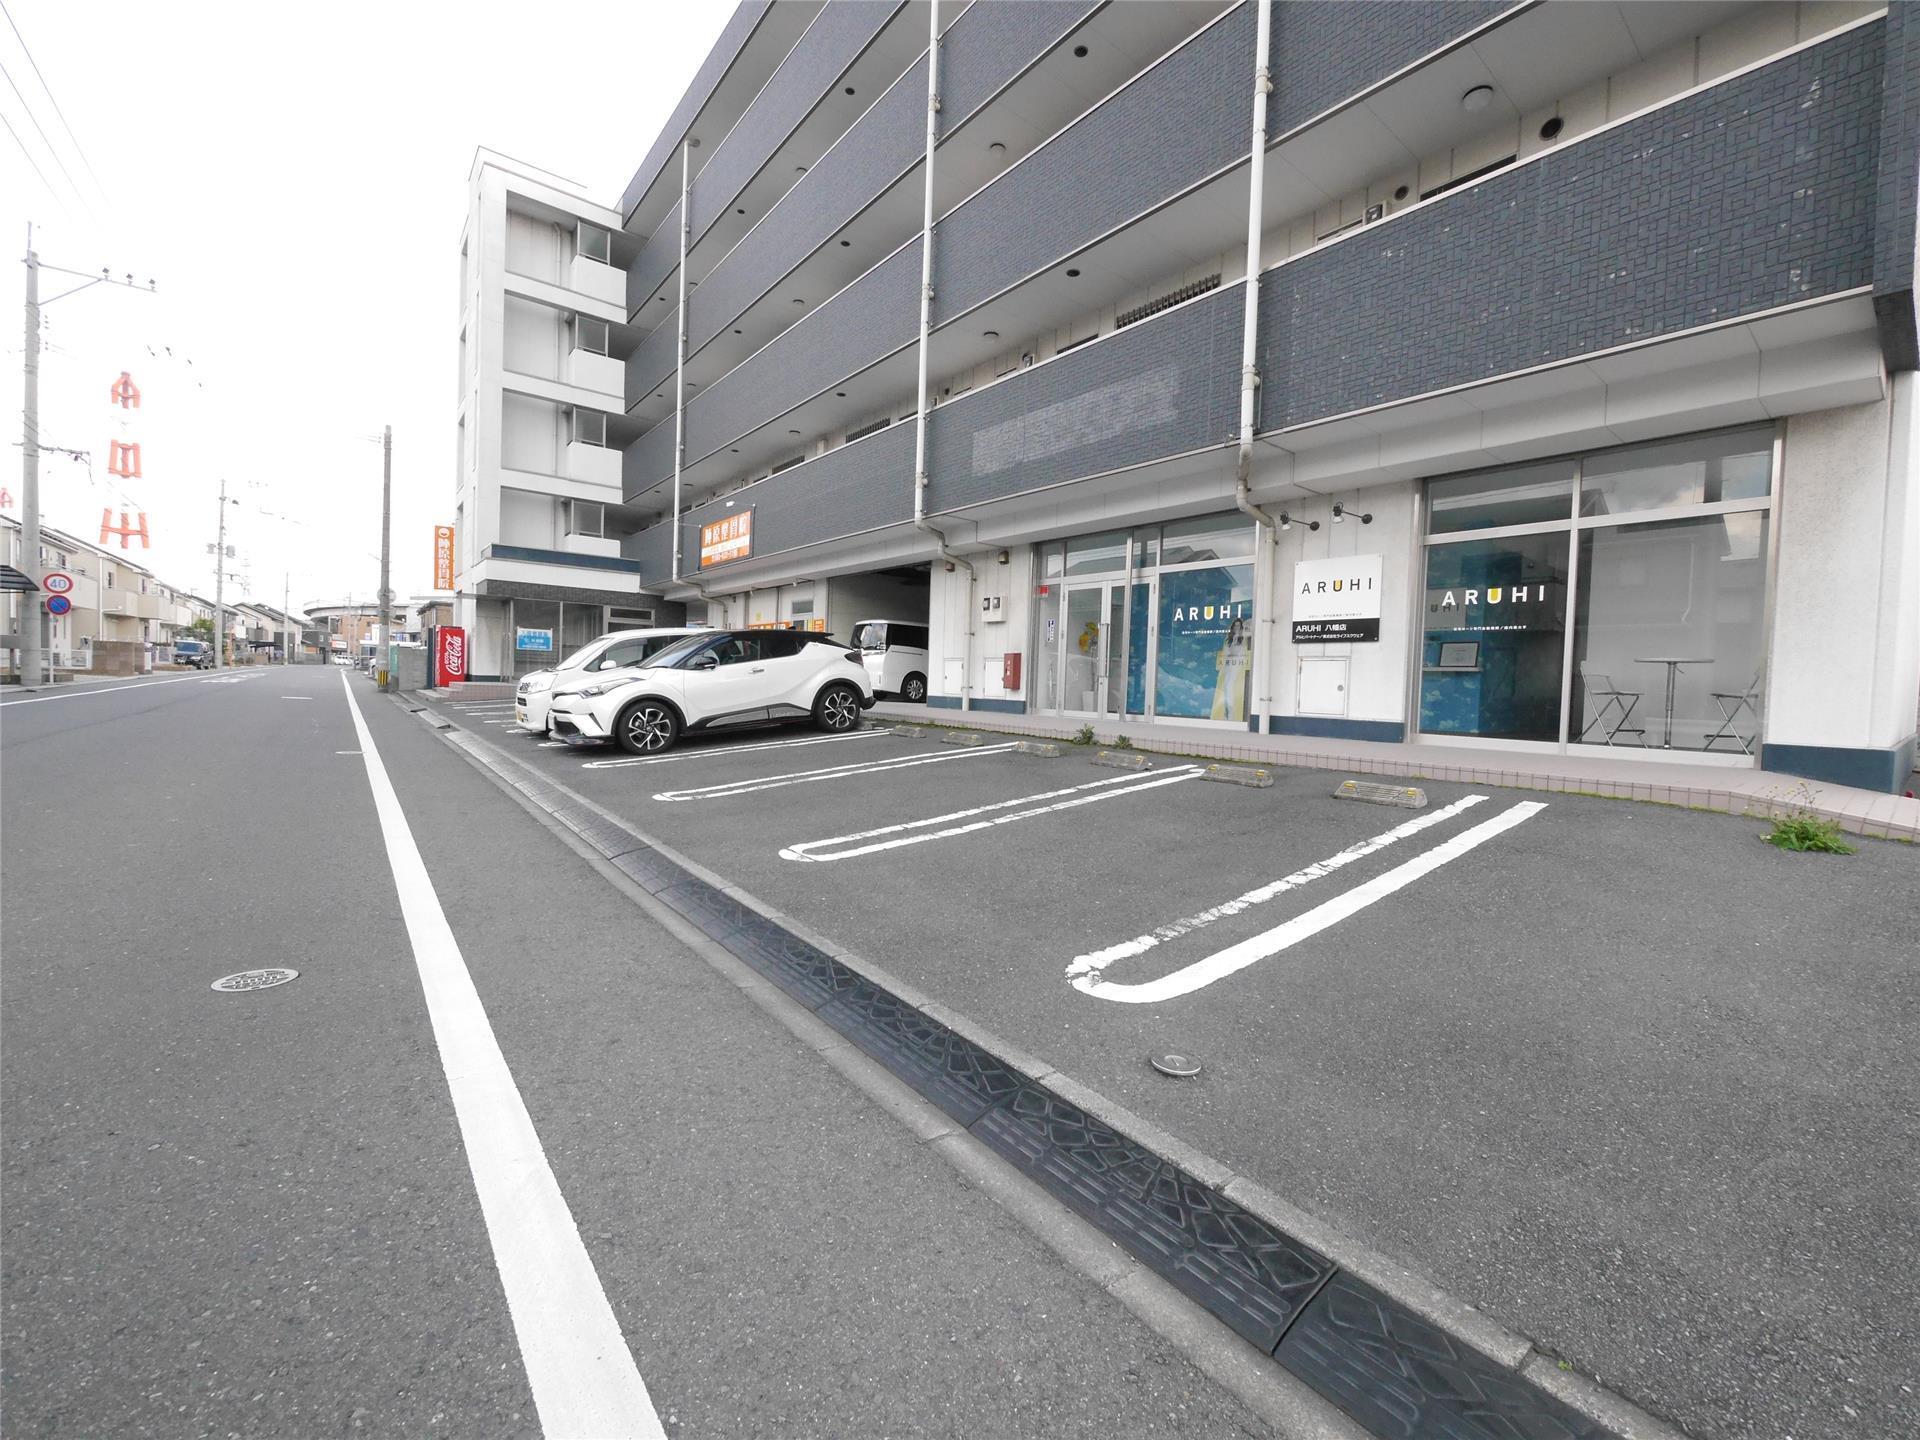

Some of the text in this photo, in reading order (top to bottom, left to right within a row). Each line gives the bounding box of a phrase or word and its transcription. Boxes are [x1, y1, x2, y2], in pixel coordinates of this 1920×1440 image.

[50, 578, 67, 588] 40
[1301, 577, 1372, 595] ARUHI
[1441, 585, 1545, 606] ARUHI
[1174, 604, 1242, 622] ARUHI
[1295, 623, 1347, 633] ARUHI 八幡店
[1217, 658, 1250, 667] ARUHI
